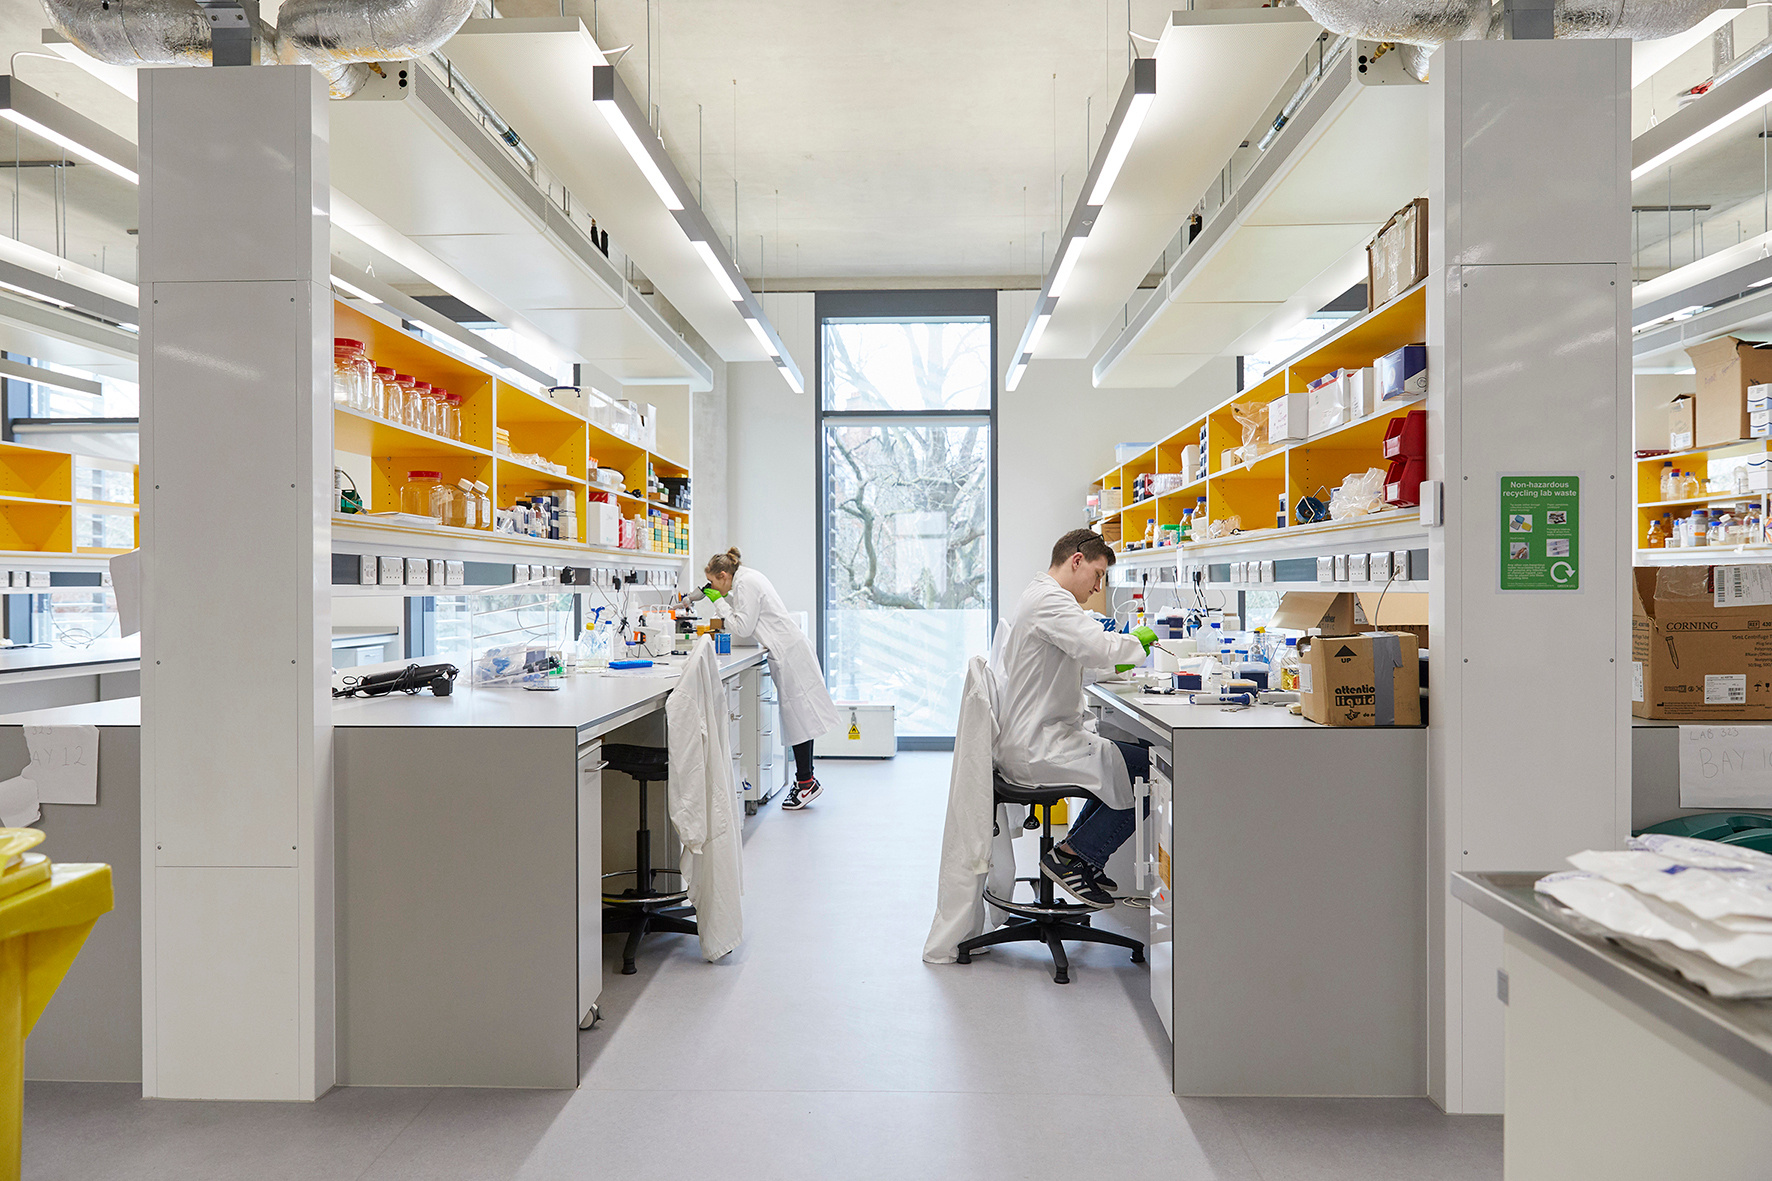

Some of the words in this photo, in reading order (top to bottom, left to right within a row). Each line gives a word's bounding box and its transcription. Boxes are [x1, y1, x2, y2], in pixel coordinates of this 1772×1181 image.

[1510, 481, 1570, 489] Non-hazardous
[1502, 489, 1539, 498] recycling
[1666, 621, 1718, 630] CORNING
[1335, 684, 1375, 694] attentio
[1336, 695, 1375, 708] liquid
[1690, 728, 1714, 741] LAB
[1720, 727, 1739, 738] 323
[62, 745, 87, 766] 12
[1699, 747, 1745, 779] BAY
